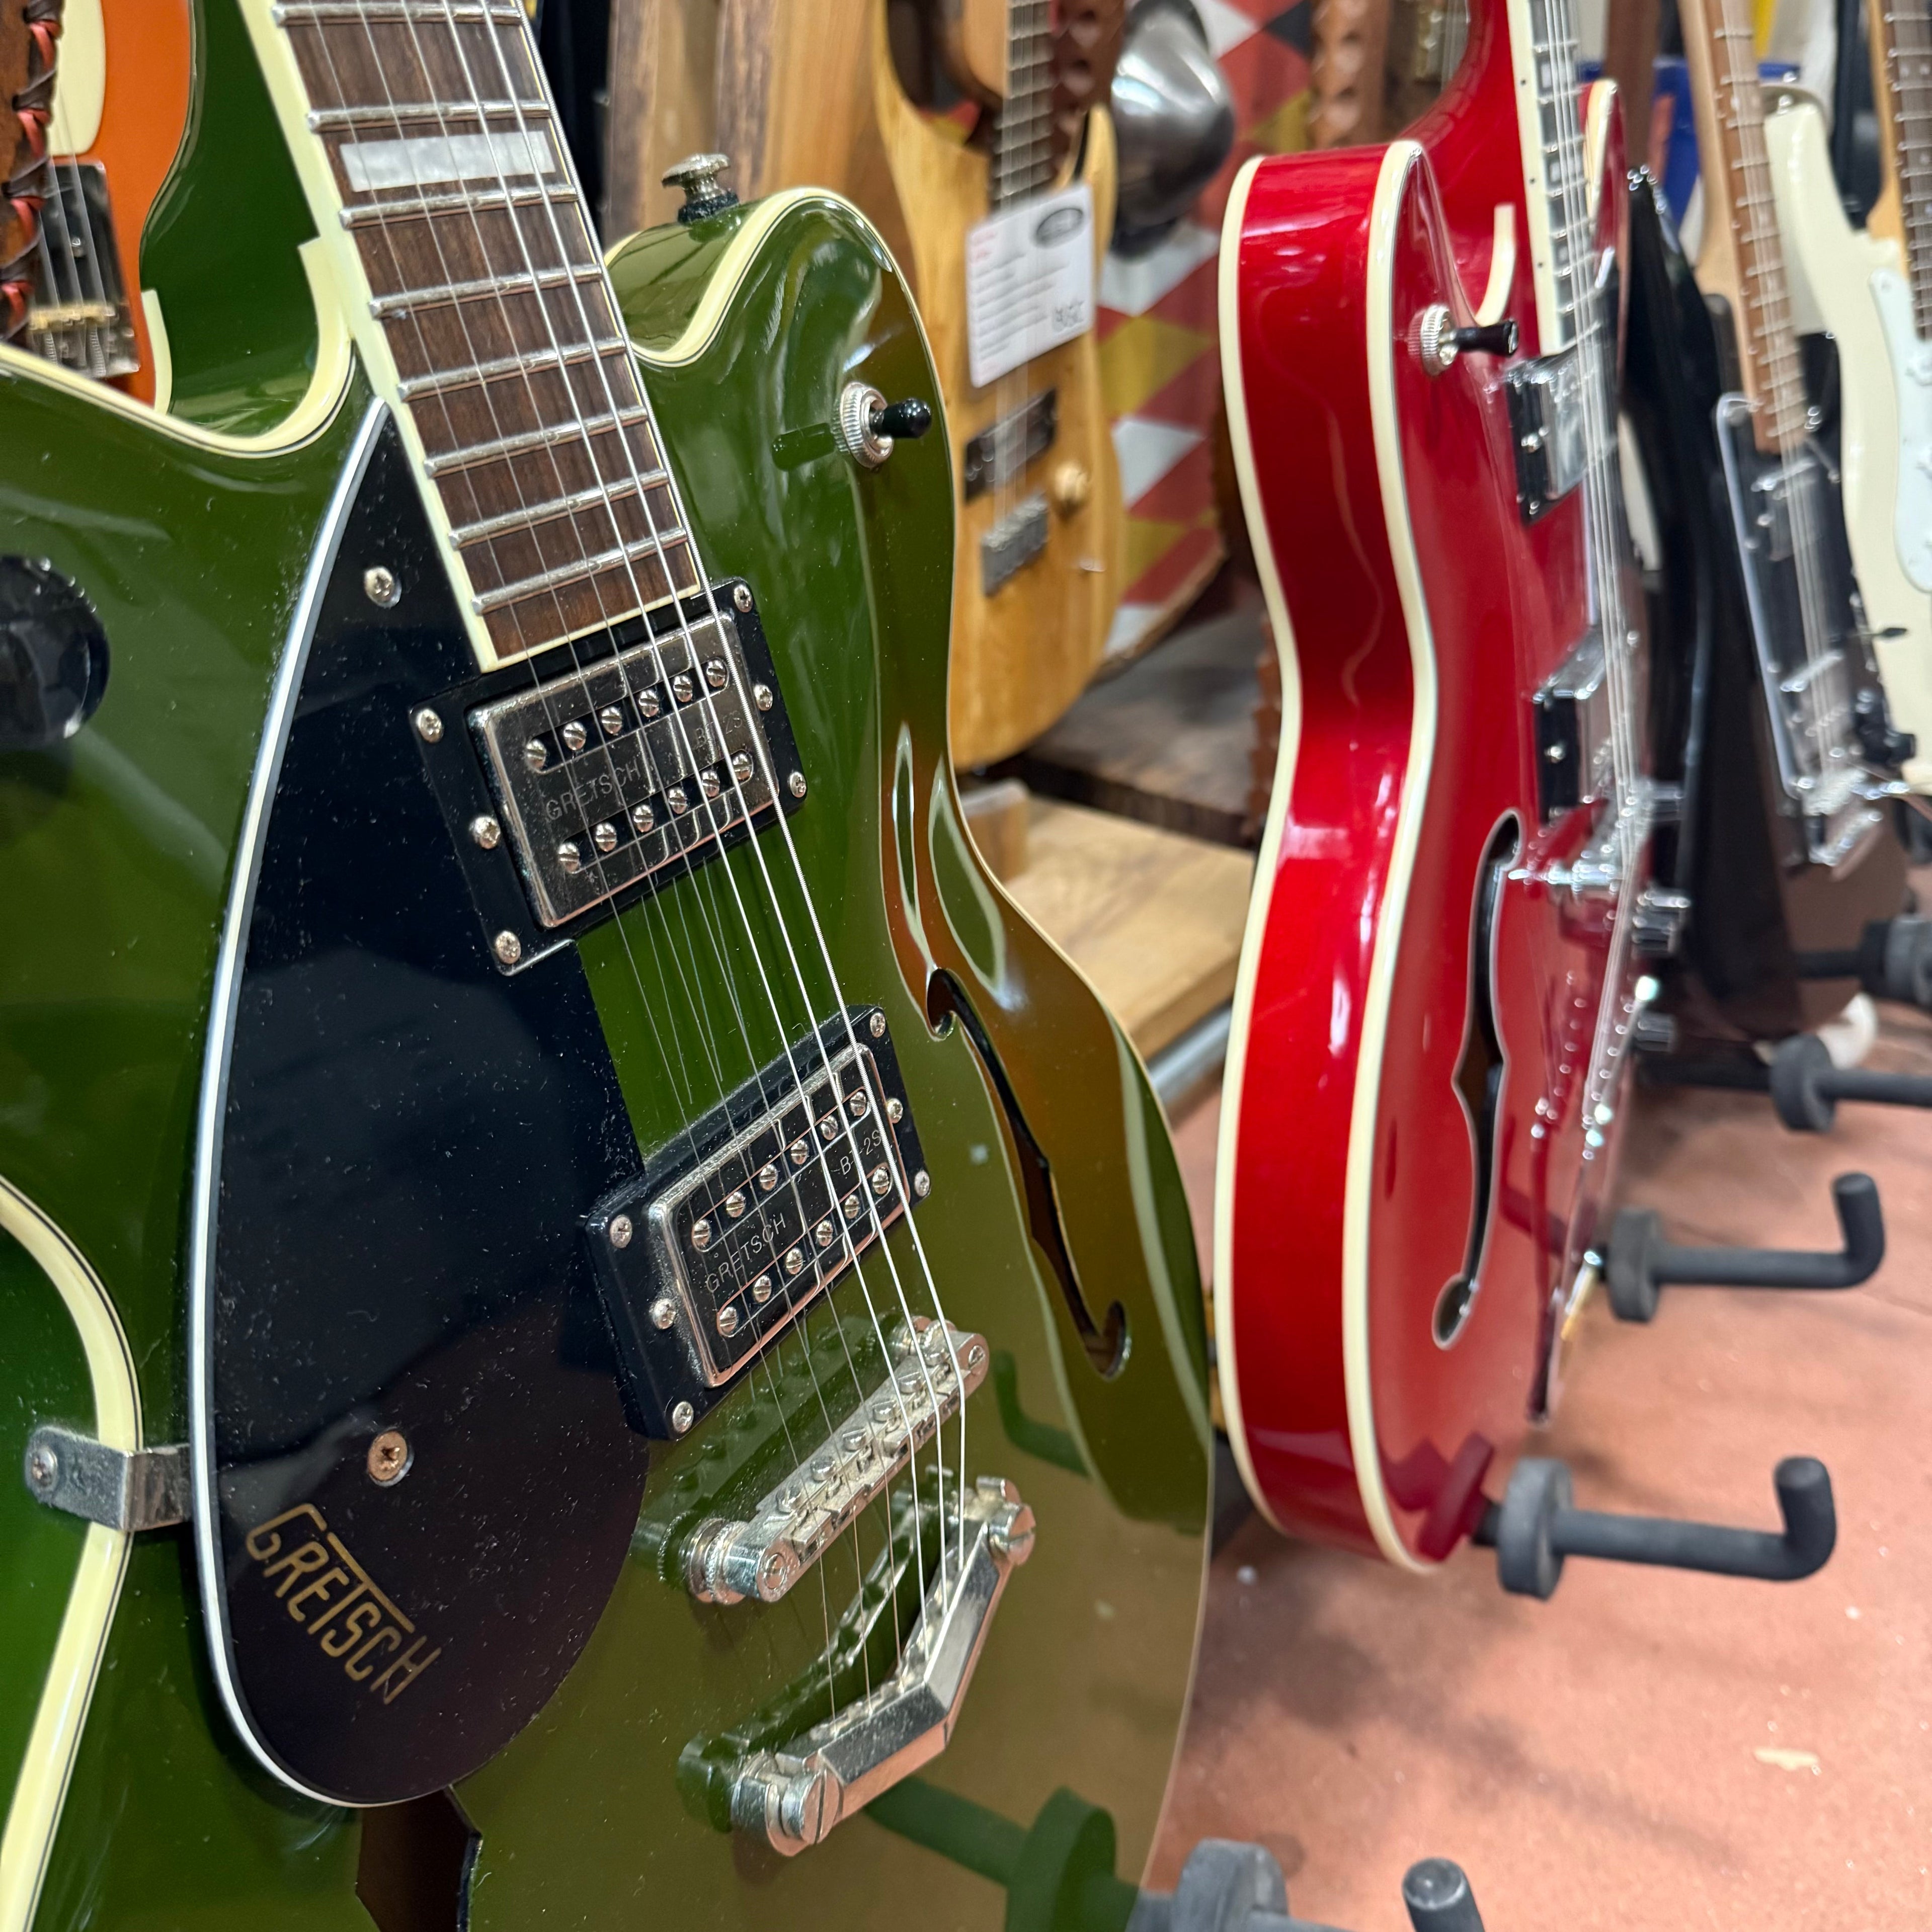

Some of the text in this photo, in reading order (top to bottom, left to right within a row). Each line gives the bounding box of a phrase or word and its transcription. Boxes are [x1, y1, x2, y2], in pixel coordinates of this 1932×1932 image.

[546, 756, 641, 820] GRETSCH
[706, 1213, 786, 1292] GRETSCH
[246, 1503, 442, 1705] GRETSCH
